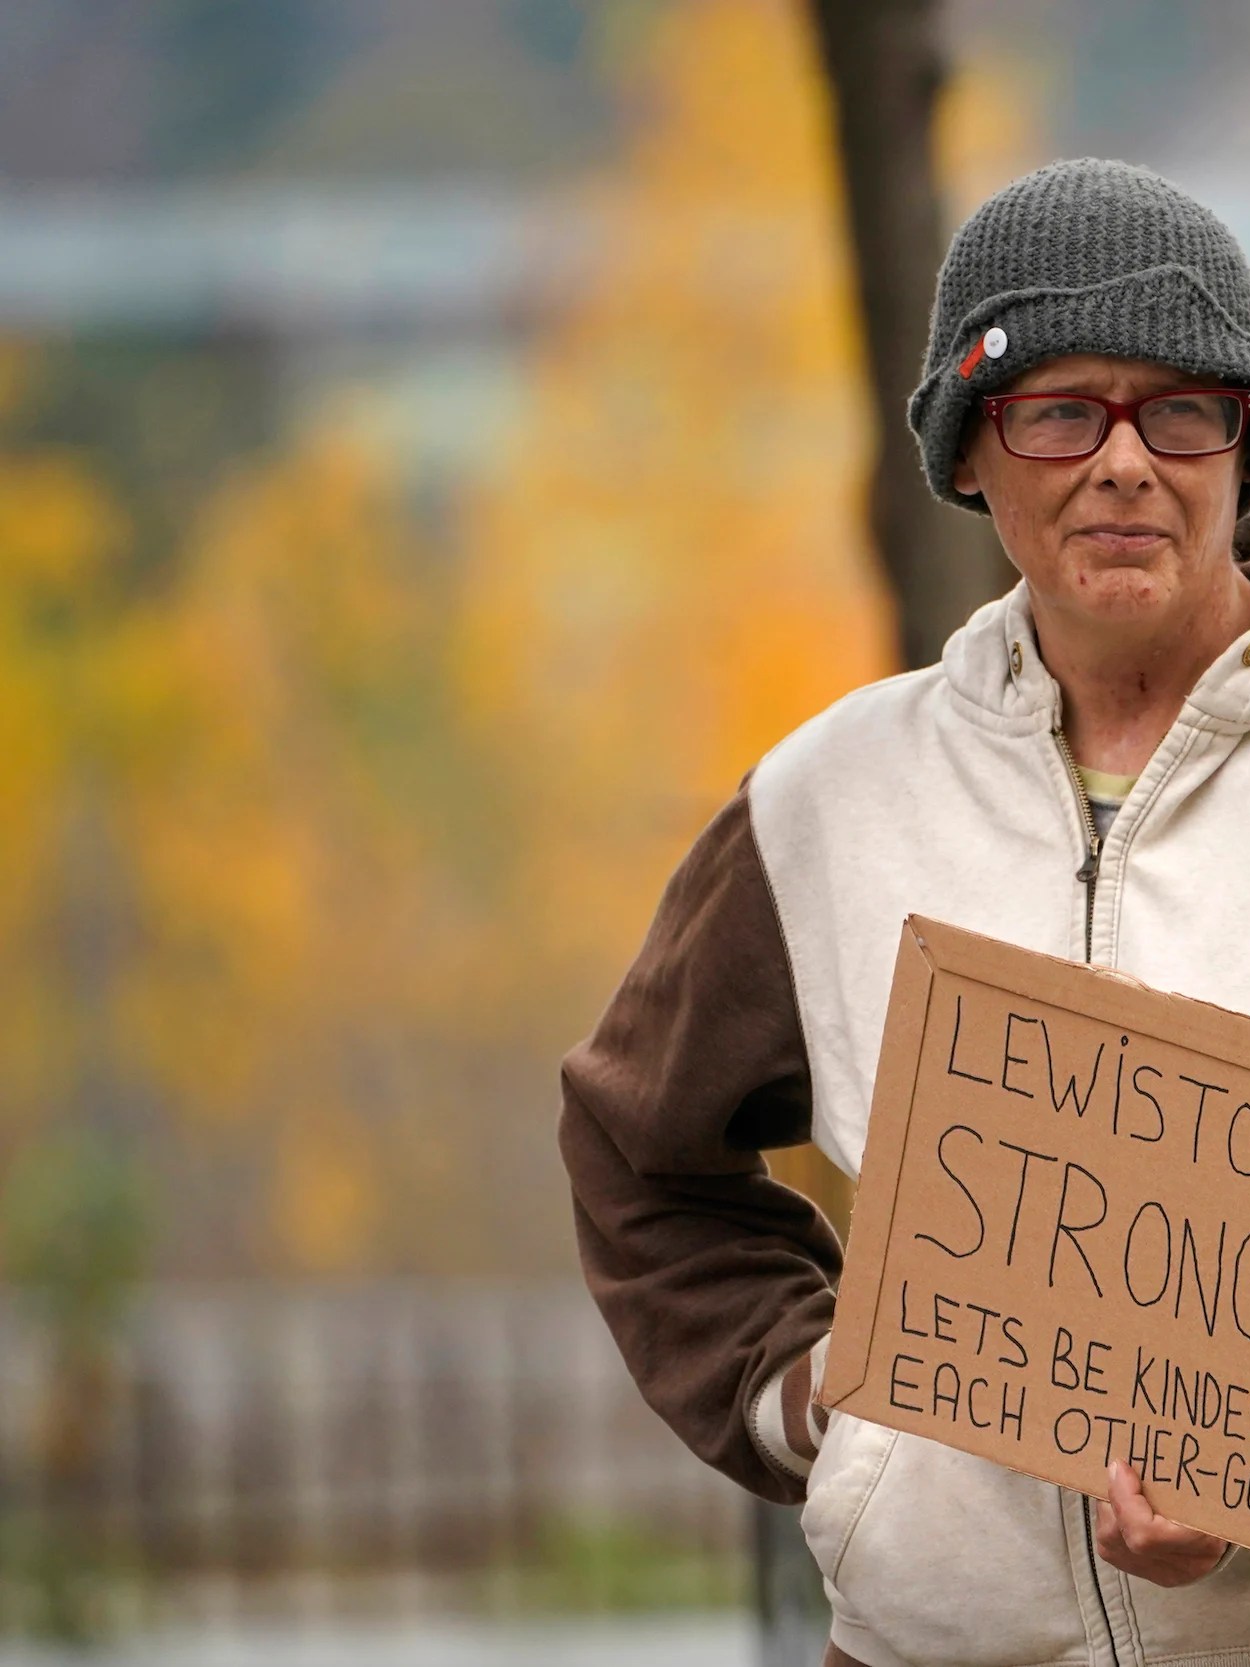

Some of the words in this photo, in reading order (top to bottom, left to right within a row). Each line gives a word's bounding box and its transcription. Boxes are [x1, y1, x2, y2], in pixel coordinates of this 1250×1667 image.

[901, 1279, 1029, 1367] LETS
[1051, 1327, 1112, 1396] BE
[889, 1354, 1026, 1441] EACH
